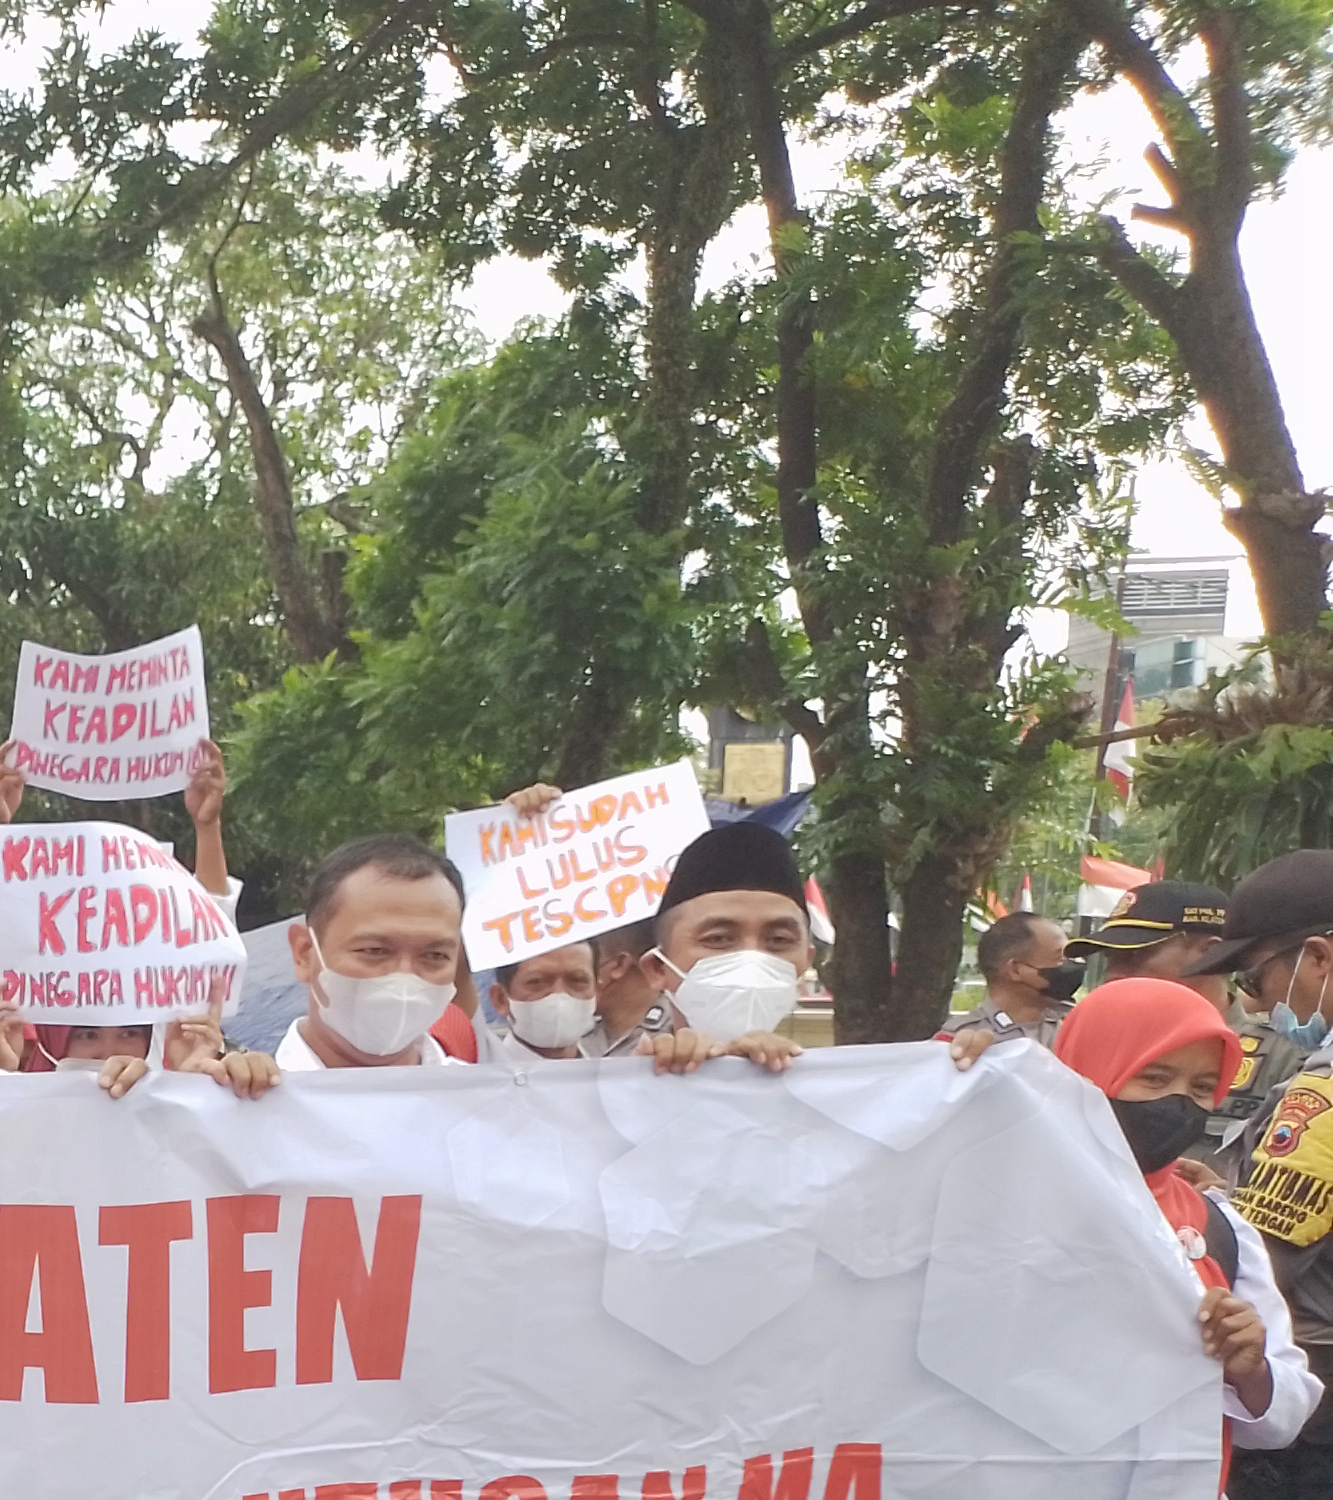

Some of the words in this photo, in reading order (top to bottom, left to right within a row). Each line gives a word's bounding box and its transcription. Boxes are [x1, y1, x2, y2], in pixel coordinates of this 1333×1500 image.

[34, 654, 100, 693] KAMI
[105, 645, 190, 695] MEMINTA
[43, 686, 195, 744] KEADILAN
[2, 835, 85, 883] KAMI
[516, 825, 648, 900] LULUS
[39, 884, 230, 955] KEADILAN
